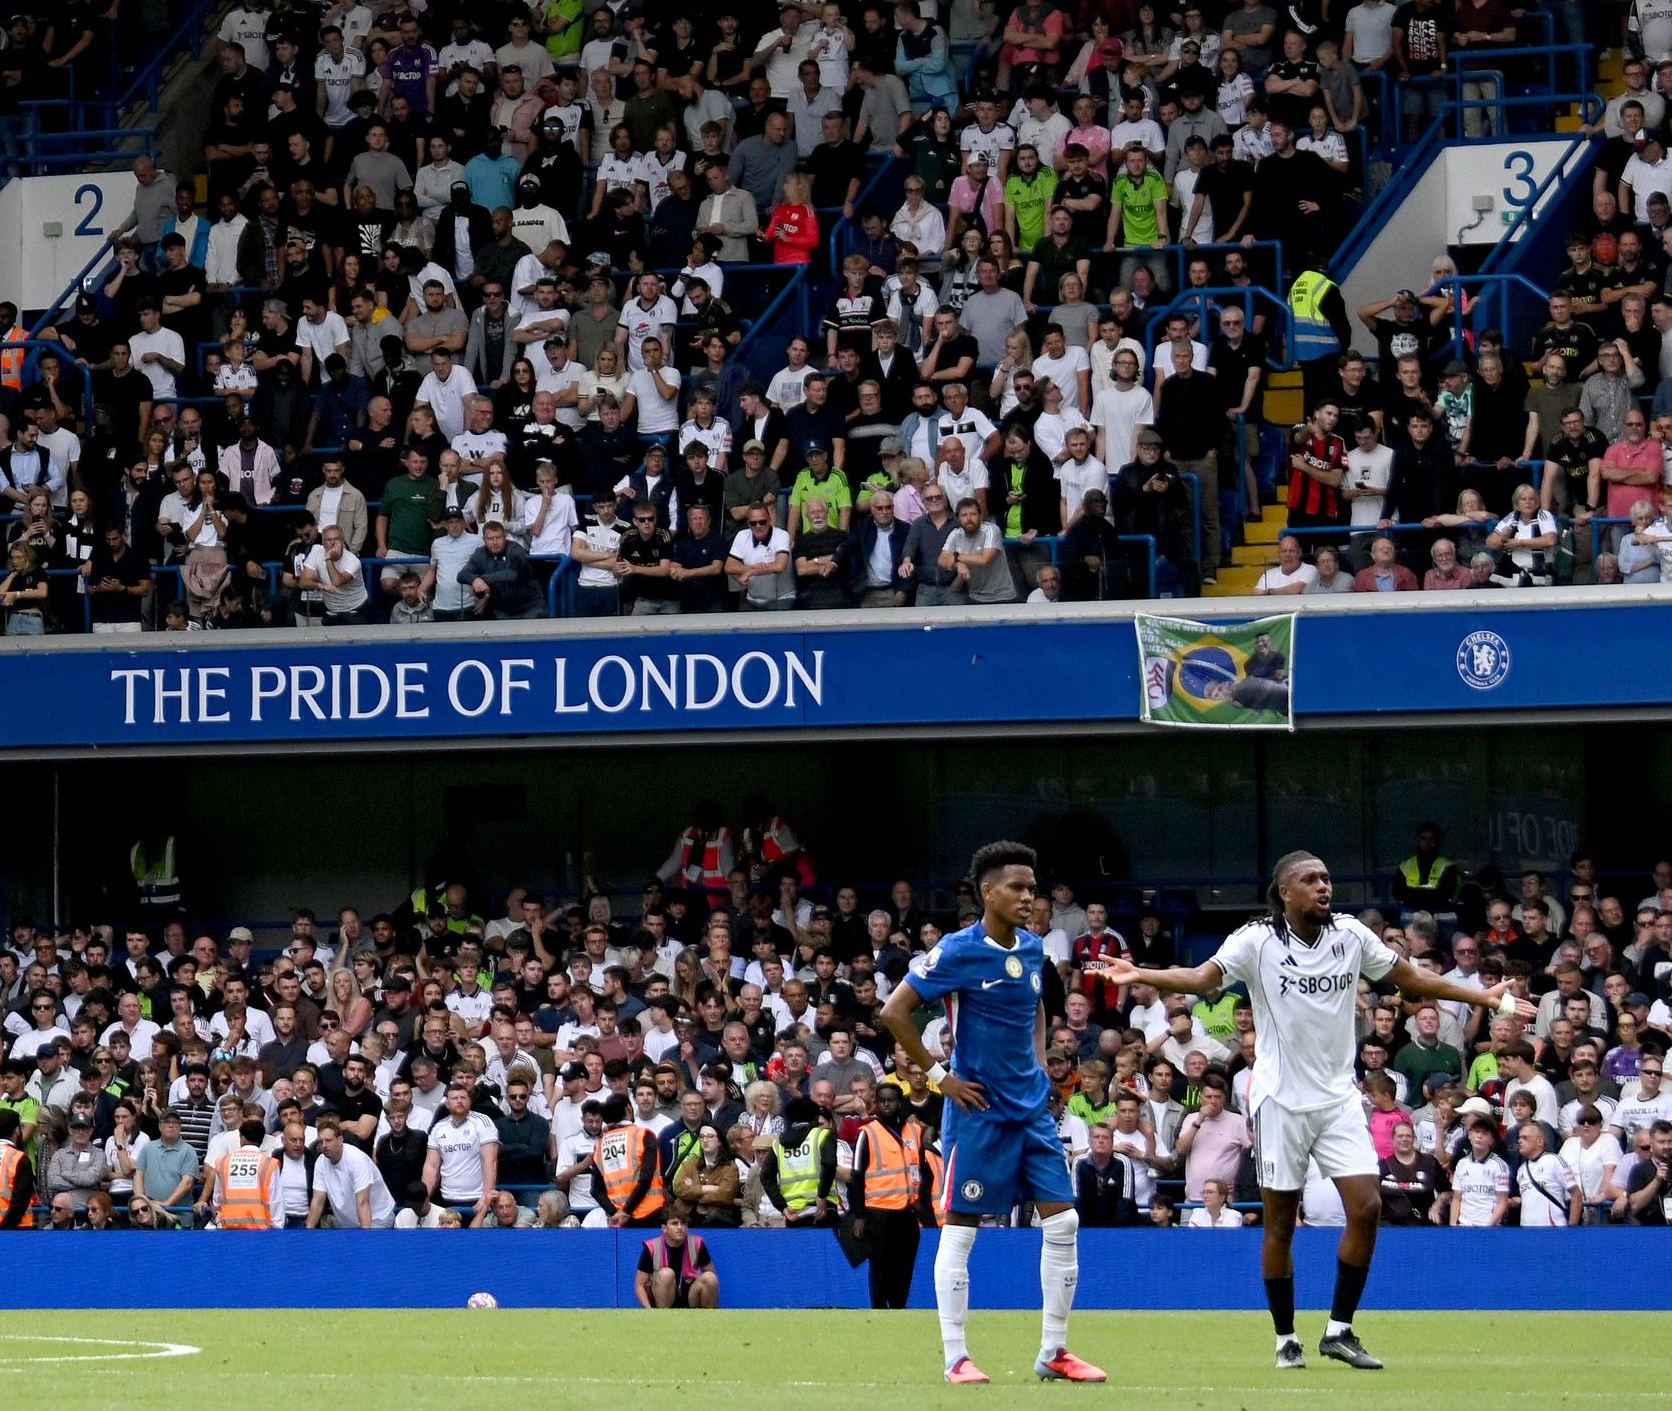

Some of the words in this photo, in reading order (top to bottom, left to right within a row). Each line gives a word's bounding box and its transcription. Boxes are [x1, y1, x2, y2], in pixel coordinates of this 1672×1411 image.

[1503, 150, 1537, 207] 3
[73, 182, 105, 237] 2
[1465, 633, 1501, 647] CHELSEA
[110, 666, 232, 724] THE
[249, 661, 431, 722] PRIDE
[447, 657, 535, 717] OF
[554, 649, 826, 714] LONDON
[1298, 973, 1354, 994] SBOTOP
[602, 1144, 626, 1161] 204
[229, 1164, 258, 1176] 255
